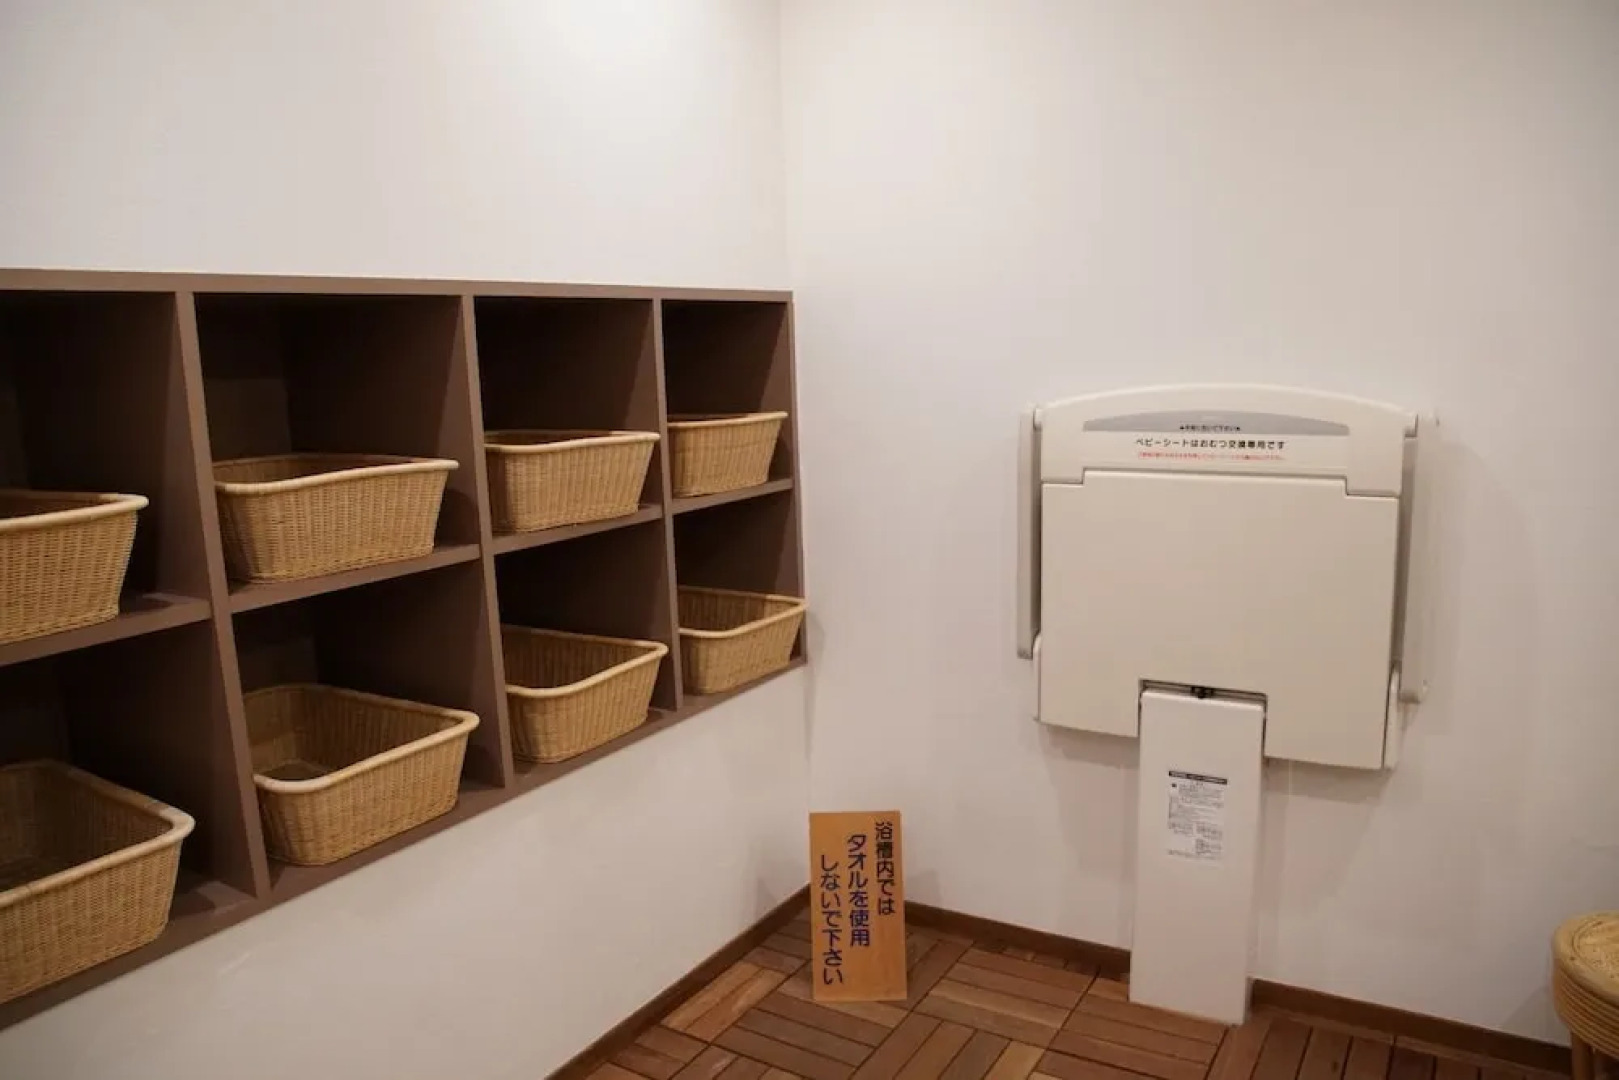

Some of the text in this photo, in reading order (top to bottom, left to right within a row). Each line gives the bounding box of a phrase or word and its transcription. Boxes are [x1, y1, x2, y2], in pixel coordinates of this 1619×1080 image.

[820, 854, 843, 985] しないで下さい
[847, 833, 871, 947] タオルを使用
[875, 821, 896, 916] 浴槽内では
